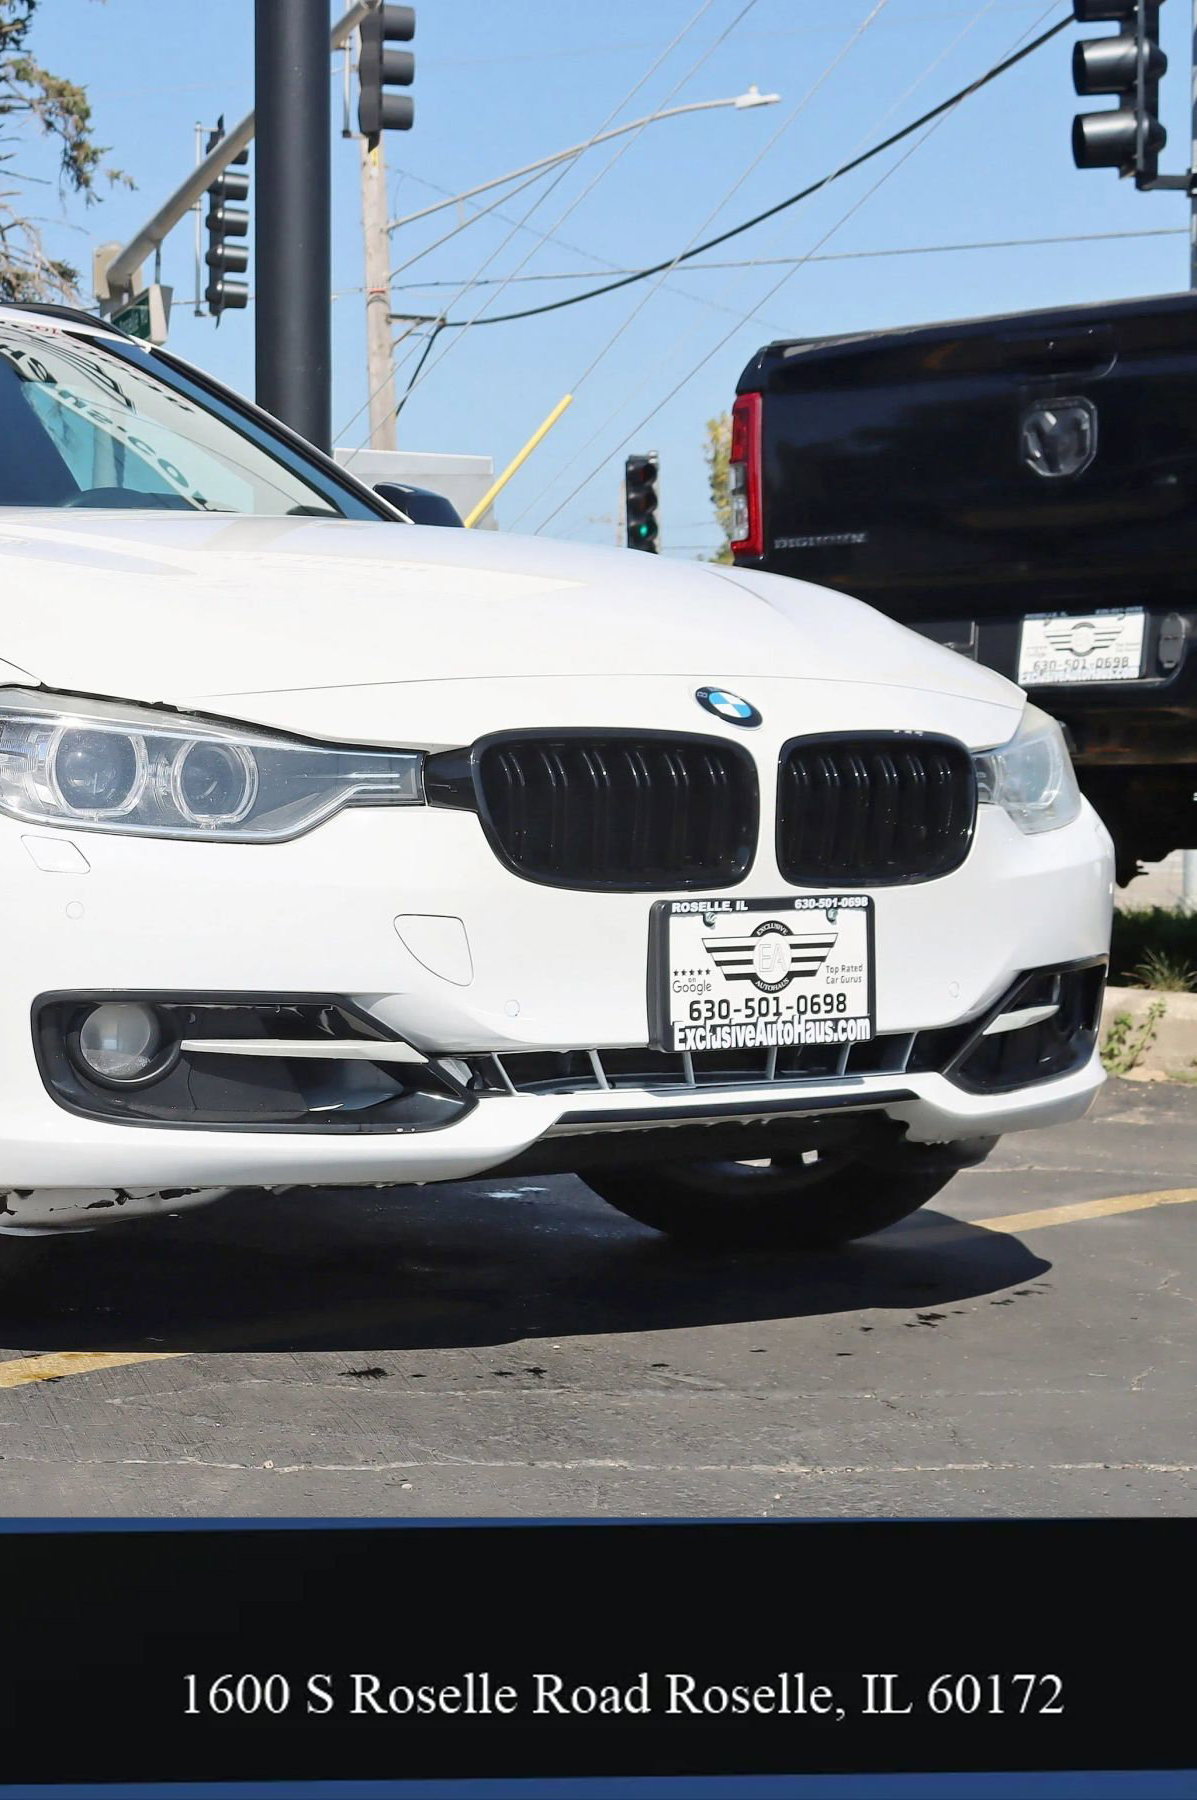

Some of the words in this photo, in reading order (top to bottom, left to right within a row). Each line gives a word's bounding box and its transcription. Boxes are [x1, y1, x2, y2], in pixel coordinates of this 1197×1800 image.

[1033, 656, 1129, 672] 630-501-0698
[671, 901, 733, 913] ROSELLE,
[736, 900, 749, 911] IL
[794, 896, 869, 909] 630-501-0698
[756, 922, 788, 936] EXCLUSIVE
[759, 943, 787, 973] EA
[826, 965, 840, 974] Top
[841, 964, 863, 973] Rated
[755, 977, 790, 991] AUTOHAUS
[826, 976, 839, 985] Car
[840, 975, 862, 984] Gurus
[672, 980, 712, 996] Google
[689, 992, 847, 1022] 630-501-0698
[673, 1014, 871, 1051] ExclusiveAutoHaus.com
